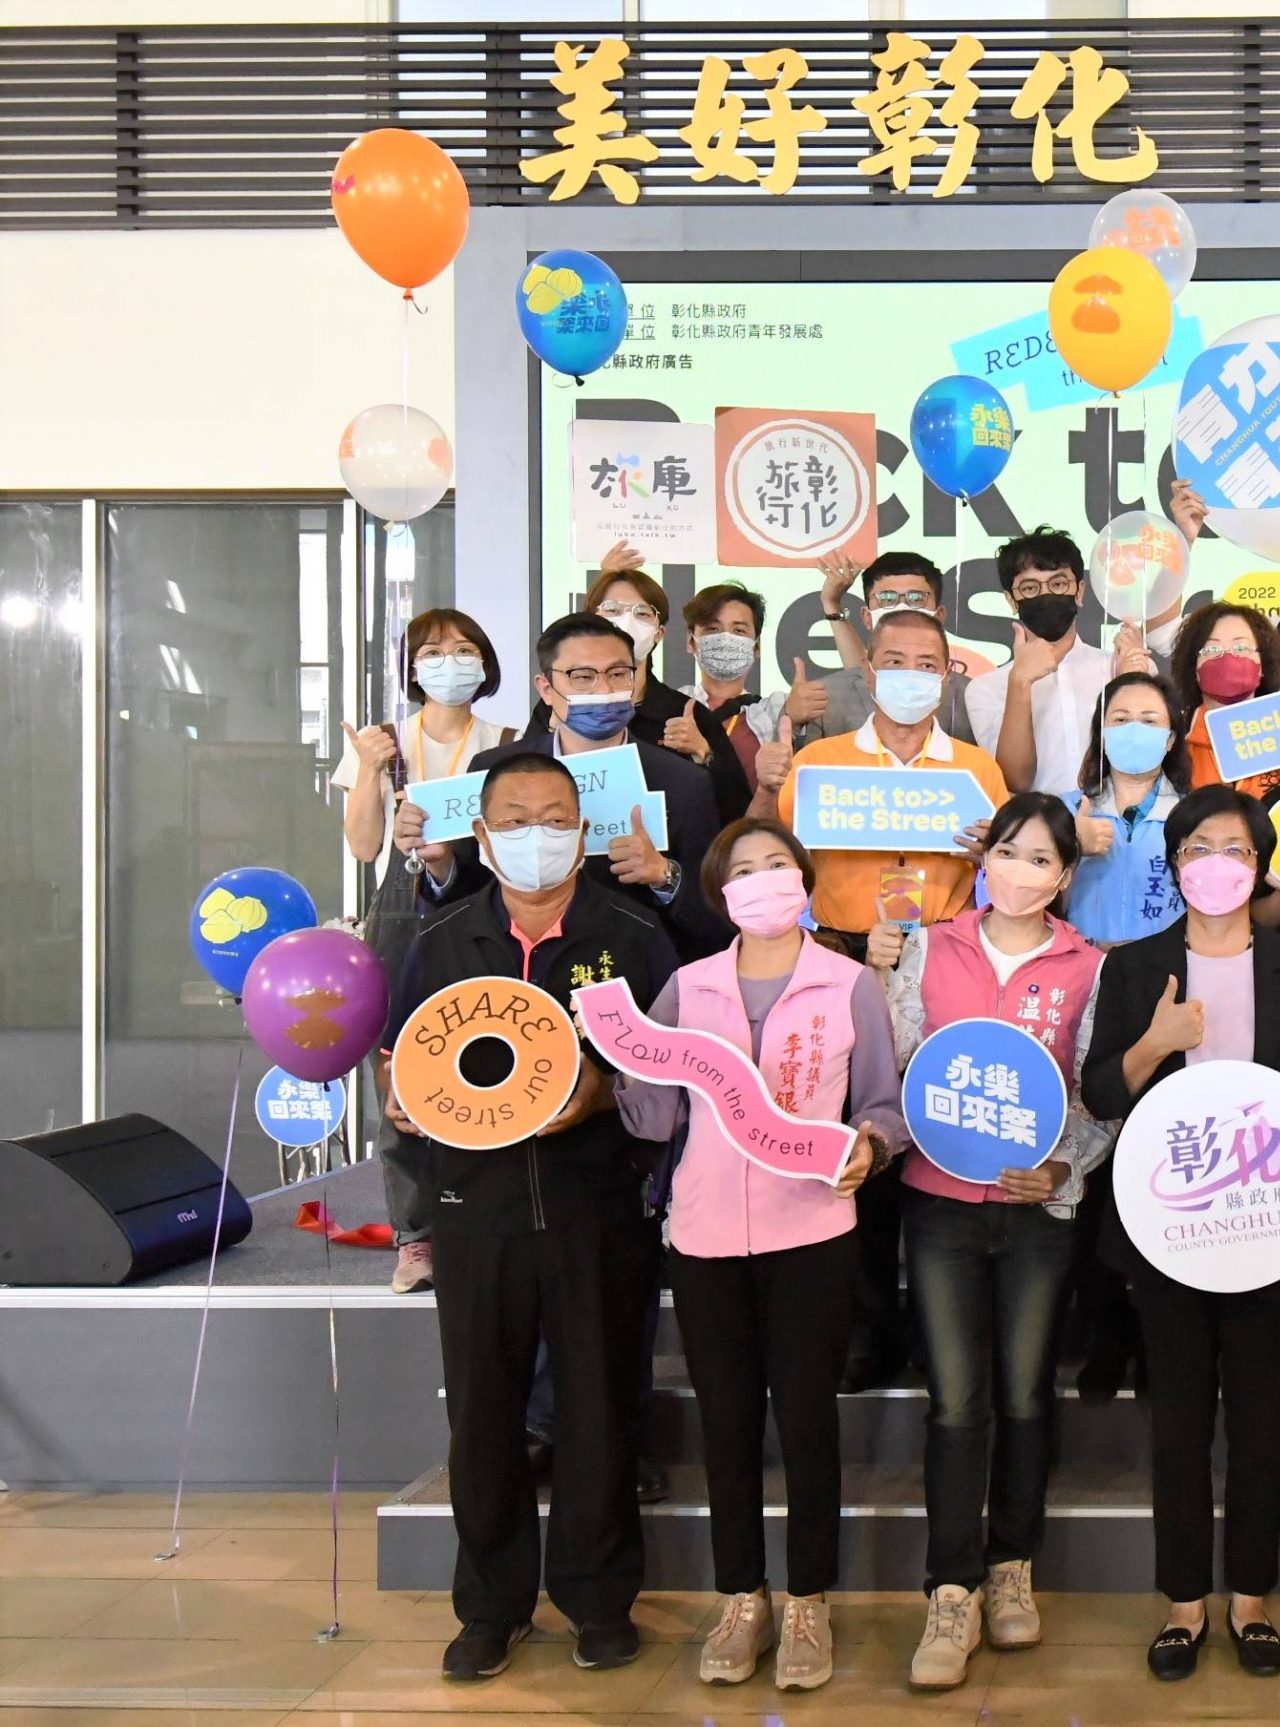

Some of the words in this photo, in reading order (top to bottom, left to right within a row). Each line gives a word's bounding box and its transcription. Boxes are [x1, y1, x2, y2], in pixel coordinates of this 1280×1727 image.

[519, 33, 1160, 205] 美好彰化
[671, 303, 747, 319] 彰化縣政府
[671, 324, 824, 340] 彰化縣政府青年發展處
[1238, 586, 1277, 600] 2022
[1234, 736, 1278, 762] the
[818, 784, 886, 808] Back
[818, 807, 866, 831] the
[871, 808, 961, 832] Street
[414, 991, 558, 1057] SHARE
[524, 1057, 553, 1104] our
[945, 1053, 1021, 1105] 永樂
[423, 1086, 516, 1129] street
[681, 1050, 725, 1087] from
[723, 1086, 746, 1122] the
[747, 1126, 815, 1157] street
[924, 1083, 1039, 1148] 回來祭
[1167, 1237, 1217, 1254] COUNTY
